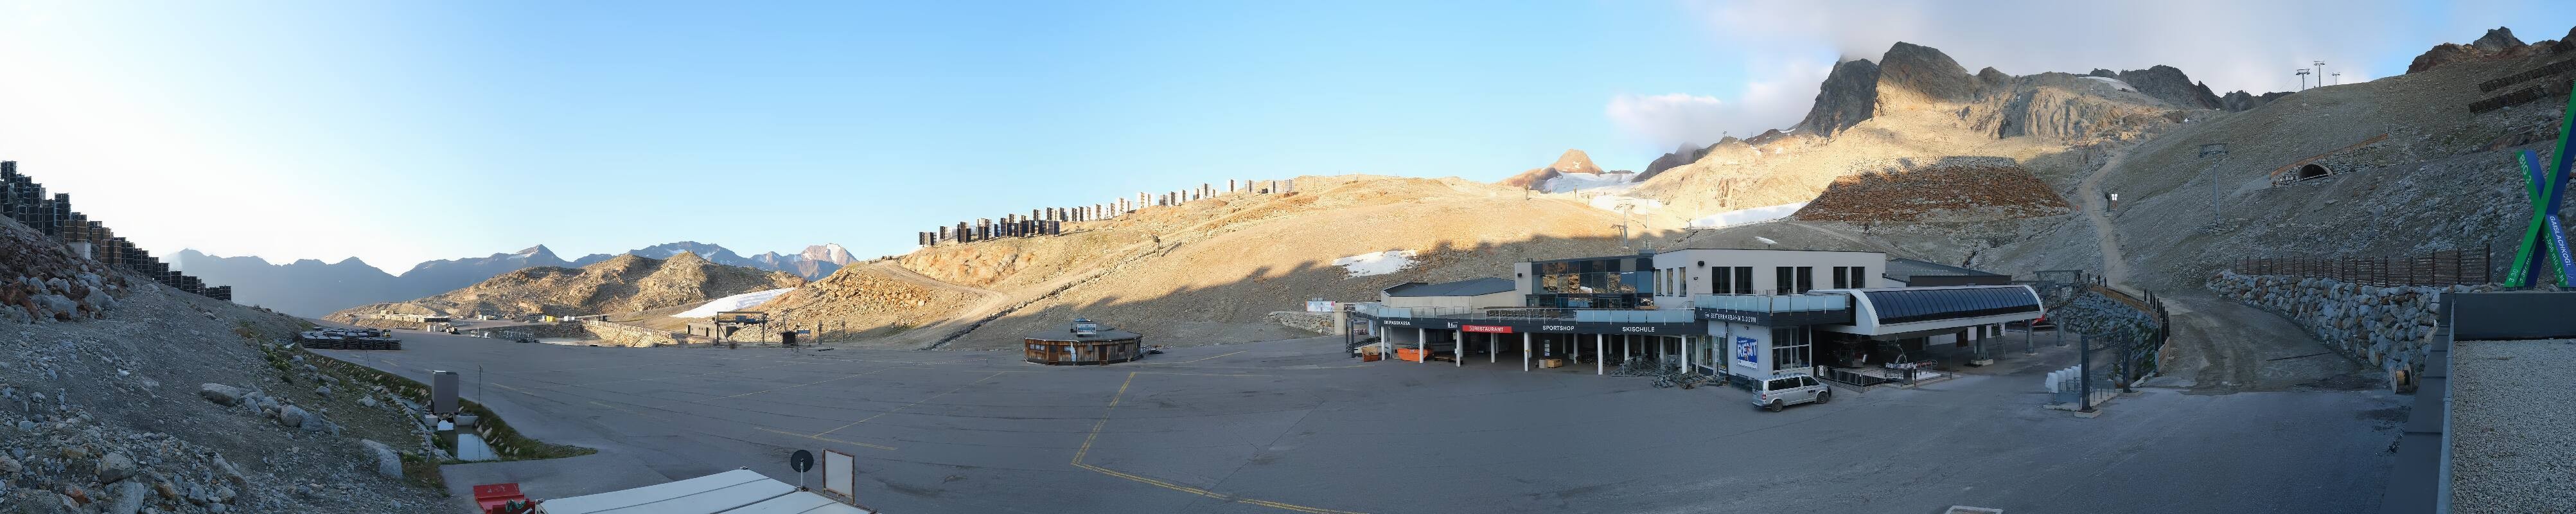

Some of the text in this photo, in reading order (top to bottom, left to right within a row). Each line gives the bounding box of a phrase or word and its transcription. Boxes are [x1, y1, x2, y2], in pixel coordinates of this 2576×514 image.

[2518, 154, 2532, 184] BIG 3
[2550, 216, 2572, 267] GAISLACHKOGL
[1737, 342, 1758, 357] RENT
